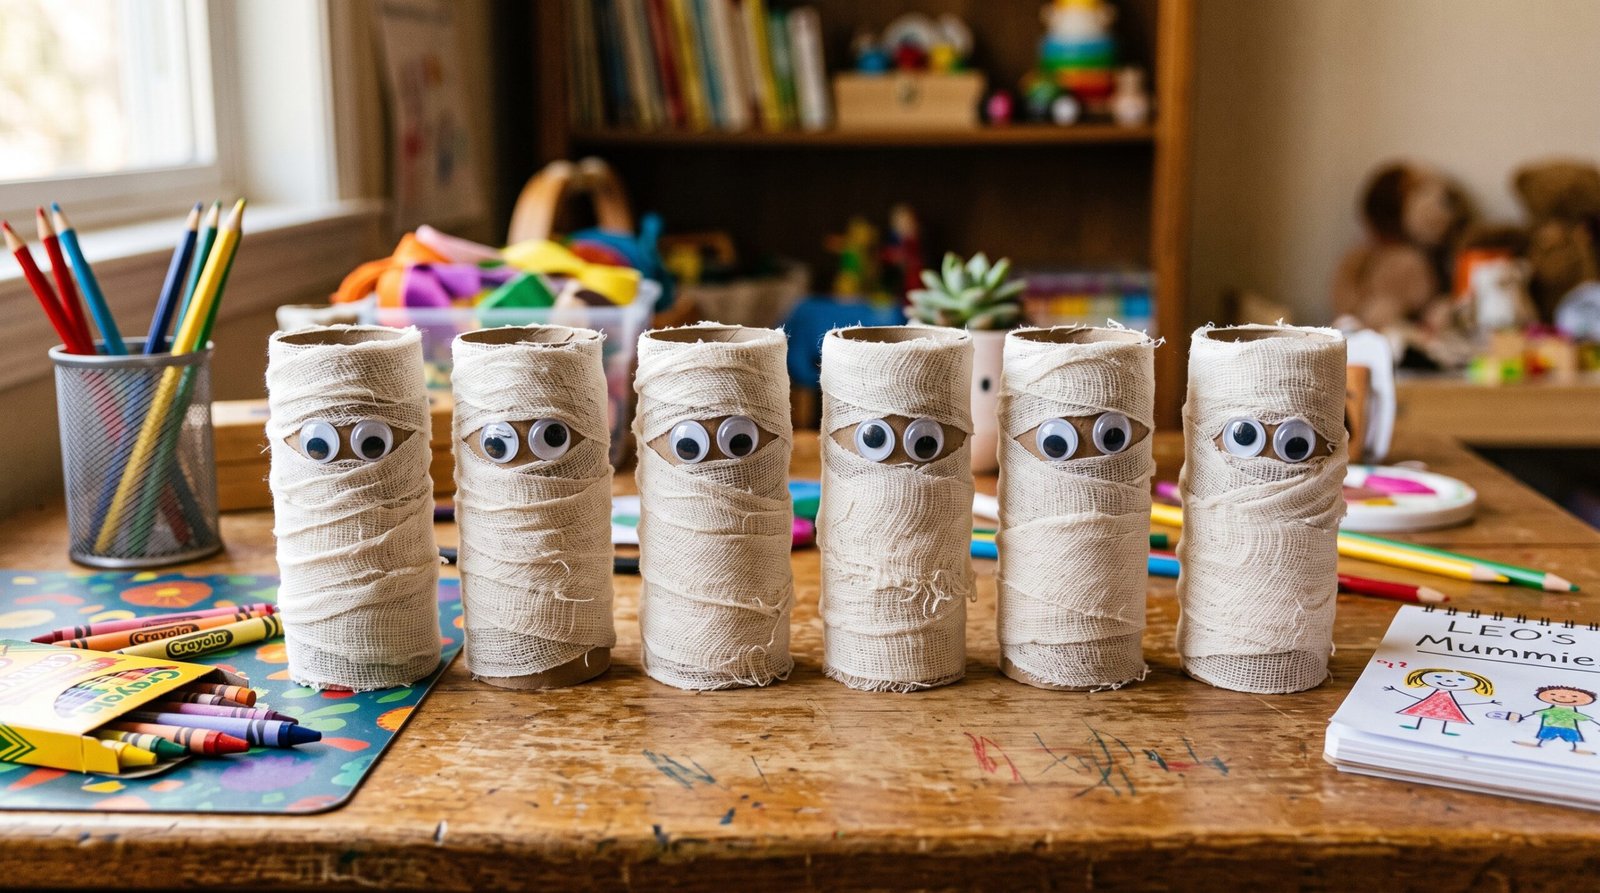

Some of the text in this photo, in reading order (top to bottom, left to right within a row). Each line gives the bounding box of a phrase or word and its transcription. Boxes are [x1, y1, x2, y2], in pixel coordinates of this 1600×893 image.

[134, 625, 189, 645] Crayola
[169, 632, 225, 655] Crayola
[1448, 620, 1576, 645] LEO'S
[1416, 634, 1600, 668] Mummie
[81, 670, 181, 714] Crayola
